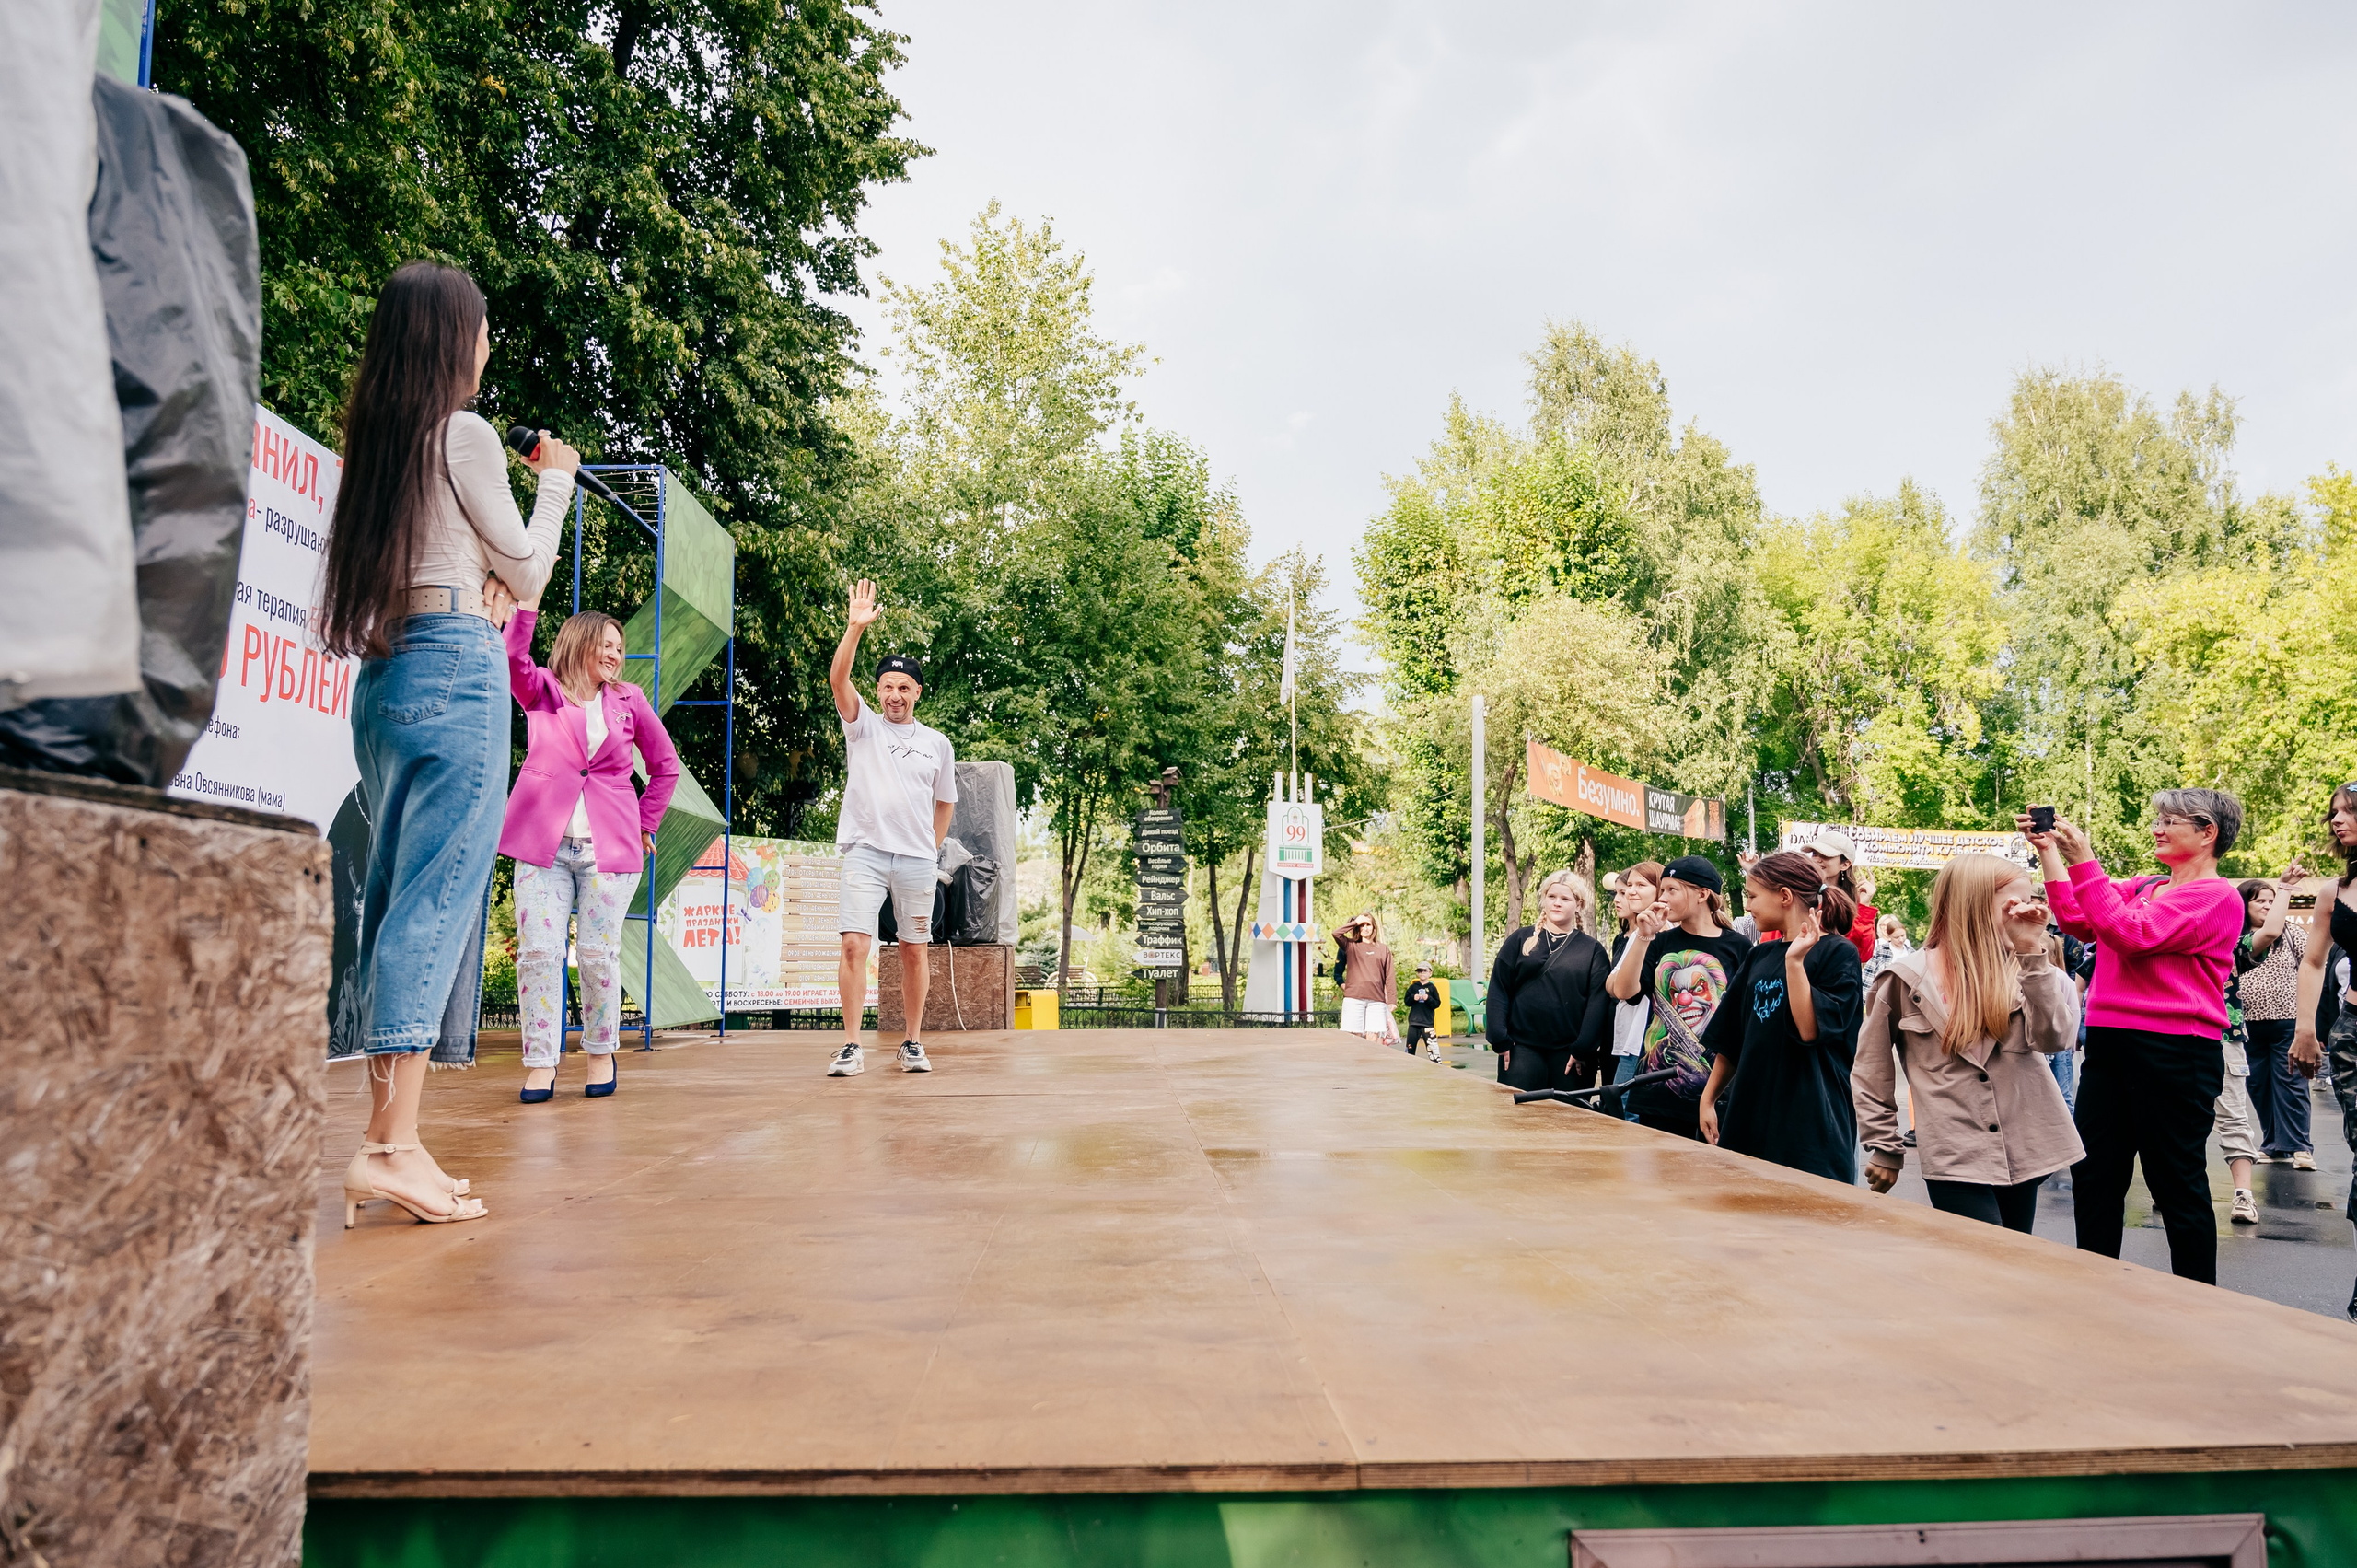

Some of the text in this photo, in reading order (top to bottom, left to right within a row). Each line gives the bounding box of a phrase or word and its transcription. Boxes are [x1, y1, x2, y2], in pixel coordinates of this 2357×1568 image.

[236, 581, 252, 606] ая
[257, 589, 307, 629] терапия
[241, 623, 350, 720] РУБЛЕЙ
[204, 715, 240, 738] ефона:
[195, 772, 255, 803] Овсянникова
[258, 785, 286, 812] (мама)
[1577, 767, 1640, 817] Безумно.
[1648, 791, 1676, 813] КРУТАЯ
[1286, 825, 1306, 842] 99
[1849, 826, 1907, 842] СОБИРАЕМ
[1910, 832, 1954, 845] ЛУЧШЕЕ
[1956, 836, 2004, 847] ДЕТСКОЕ
[1142, 842, 1180, 854] Орбита
[1864, 842, 1934, 855] КОМЬЮНИТИ
[1142, 876, 1180, 884] Рейнджер
[1151, 890, 1176, 900] Вальс
[1146, 906, 1178, 915] Хип-хоп
[683, 926, 741, 948] ЛЕТА!
[1142, 935, 1182, 946] Траффик
[1142, 969, 1178, 979] Туалет
[784, 997, 819, 1005] СЕМЕЙНЫЕ
